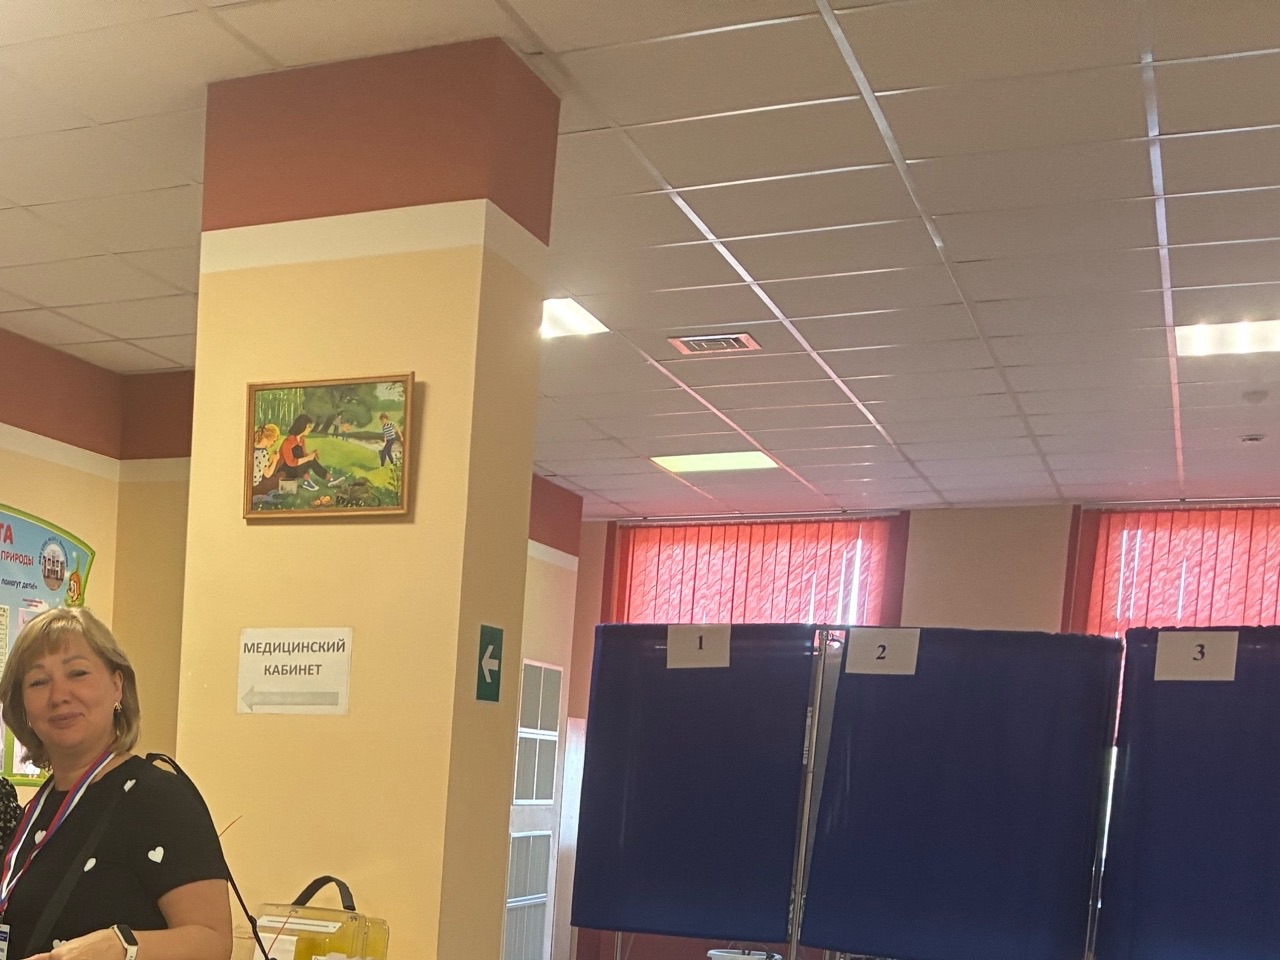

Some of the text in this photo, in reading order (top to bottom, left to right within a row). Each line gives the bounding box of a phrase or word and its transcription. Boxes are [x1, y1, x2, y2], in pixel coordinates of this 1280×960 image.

[0, 550, 34, 567] ПРИРОДЫ
[243, 638, 346, 656] МЕДИЦИНСКИЙ
[697, 635, 704, 650] 1
[875, 644, 887, 660] 2
[1192, 644, 1205, 661] 3
[264, 664, 323, 676] КАБИНЕТ
